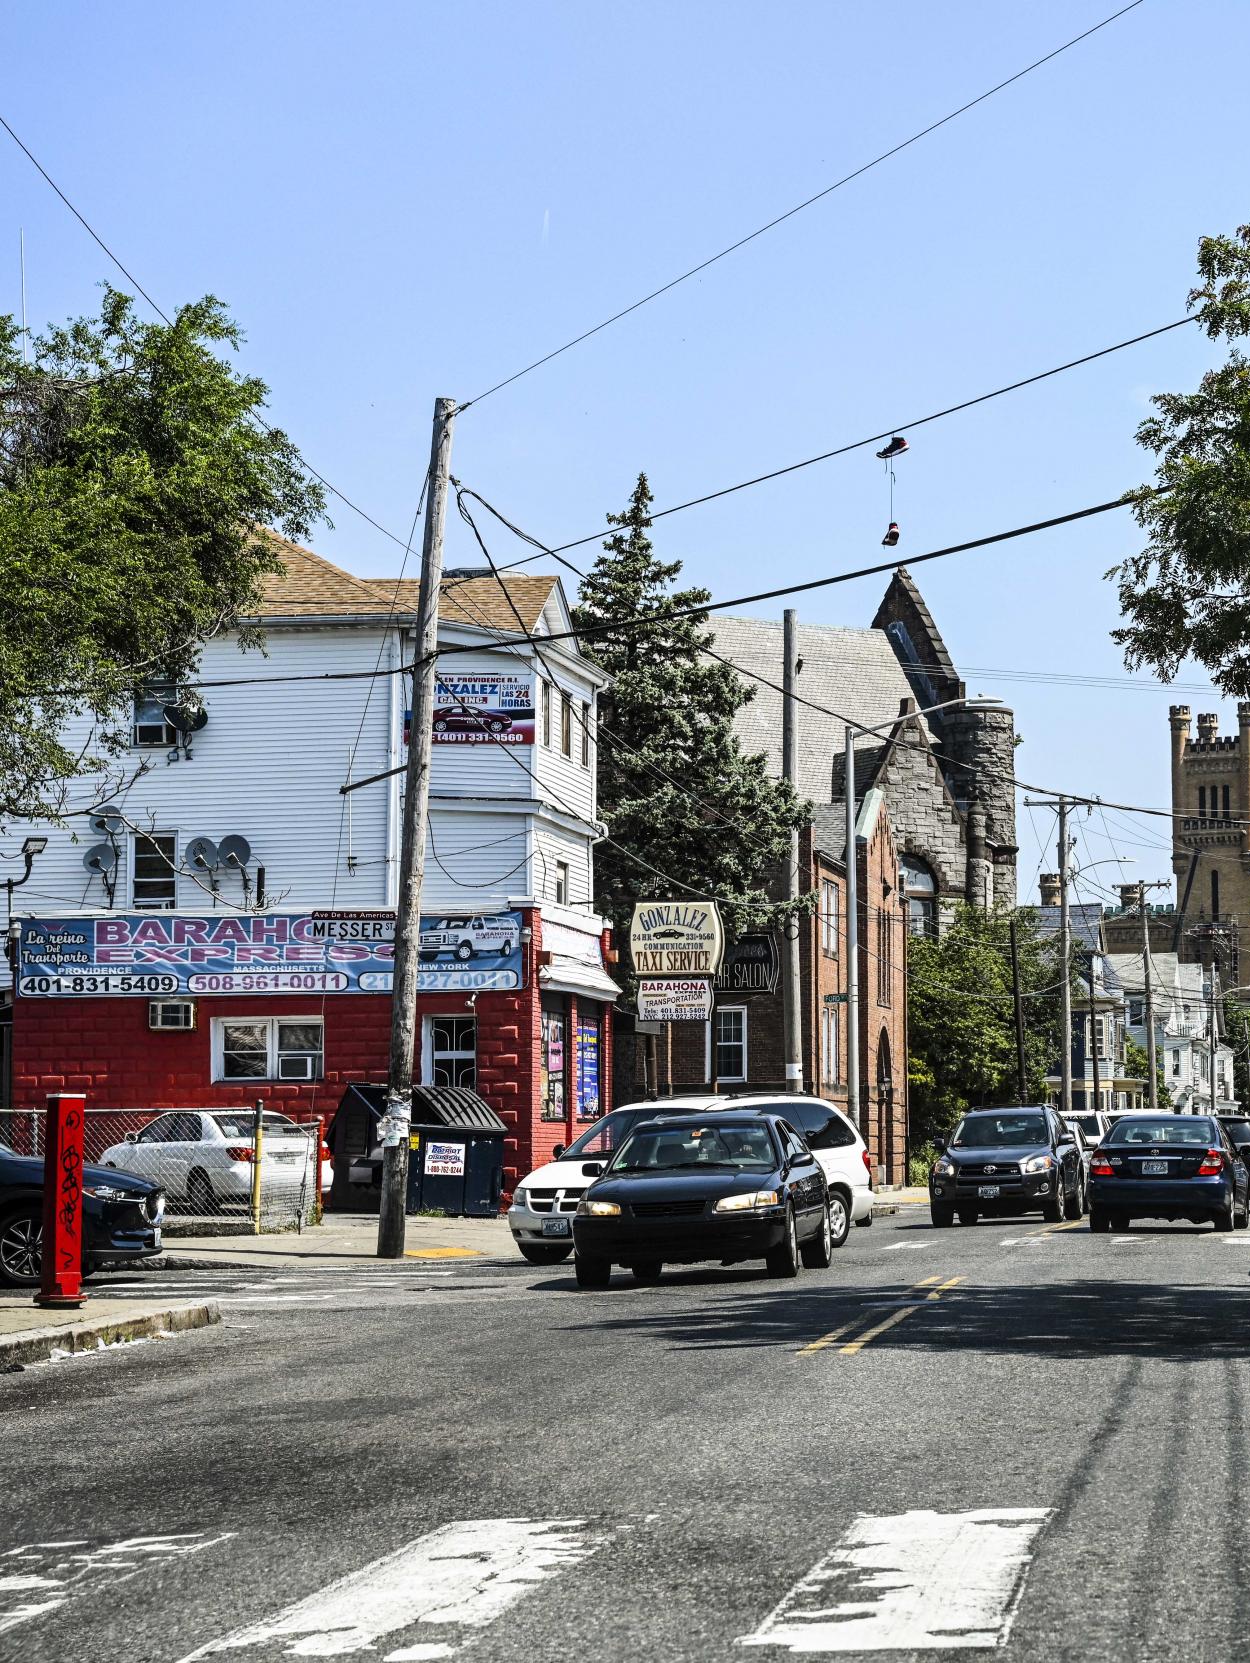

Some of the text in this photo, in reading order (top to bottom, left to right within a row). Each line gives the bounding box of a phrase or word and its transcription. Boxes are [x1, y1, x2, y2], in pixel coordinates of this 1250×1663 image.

[434, 684, 498, 694] NZALEZ
[515, 690, 529, 698] 24
[502, 699, 531, 708] HORAS
[438, 733, 523, 742] (401) 331-9560
[640, 906, 708, 932] GONZALEZ
[26, 930, 86, 944] La reina
[312, 922, 382, 938] MESSER
[45, 944, 60, 952] Del
[22, 950, 88, 965] Transporte
[636, 950, 710, 971] TAXI SERVICE
[58, 966, 132, 974] PROVIDENCE
[232, 965, 324, 973] MASSACHUSETTS
[734, 964, 769, 988] SALON
[24, 976, 174, 992] 401-831-5409
[194, 974, 342, 991] 508-961-0011
[642, 982, 706, 991] BARAHONA
[646, 993, 702, 1007] TRANSPORTATION
